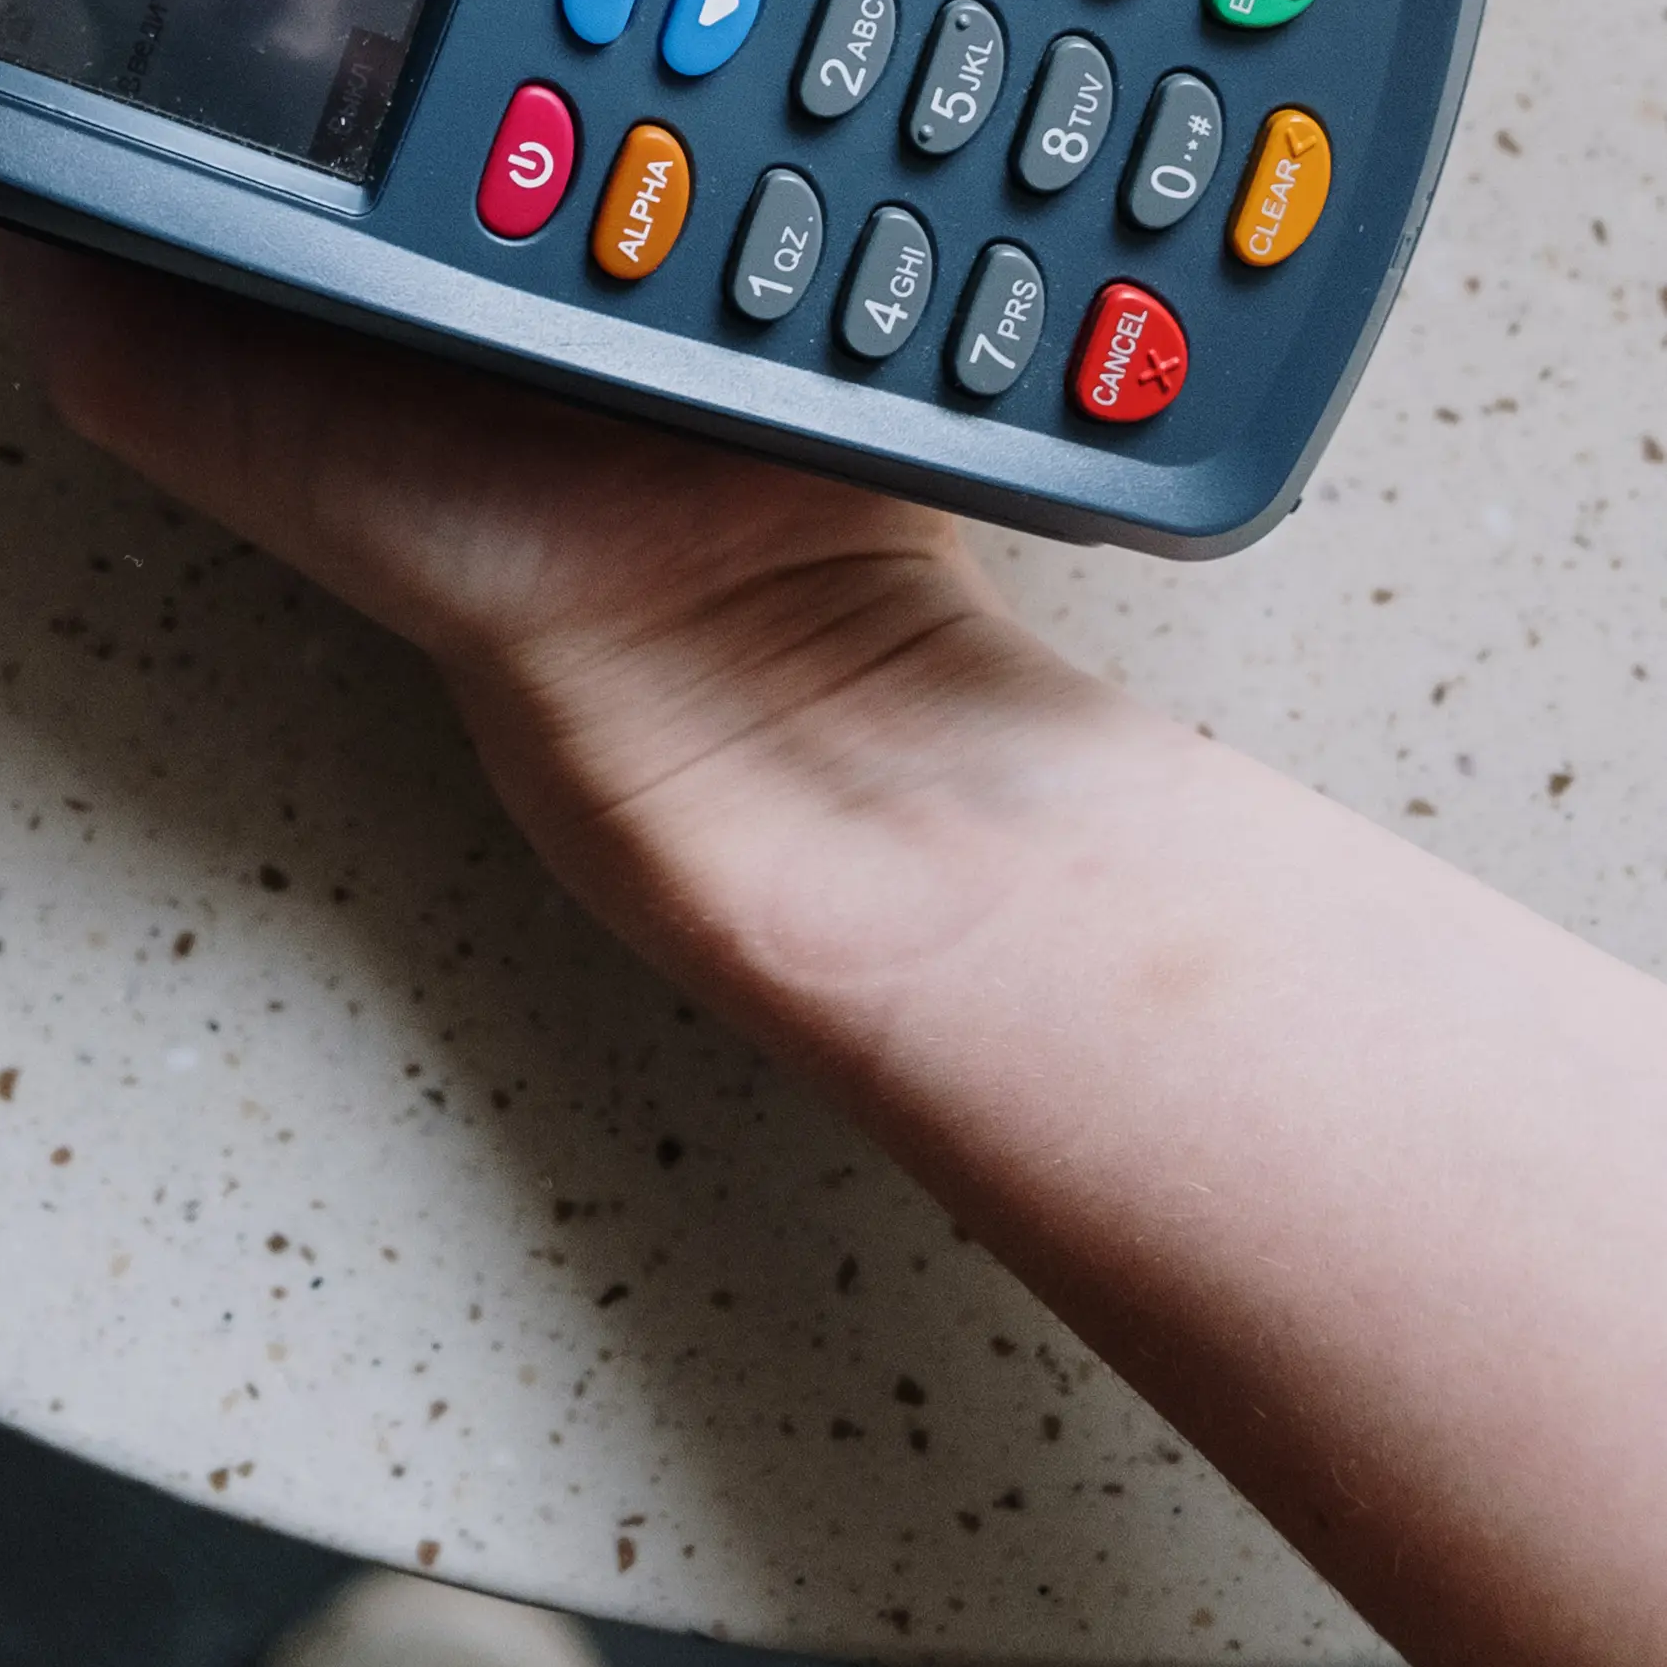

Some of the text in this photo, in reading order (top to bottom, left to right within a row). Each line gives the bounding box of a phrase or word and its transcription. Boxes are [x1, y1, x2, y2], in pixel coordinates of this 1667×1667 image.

[819, 58, 867, 97] 2
[617, 160, 674, 263] ALPHA
[1248, 158, 1302, 256] CLEAR
[747, 274, 794, 297] 1
[969, 279, 1038, 370] 7 PRS
[1092, 310, 1148, 406] CANCEL
